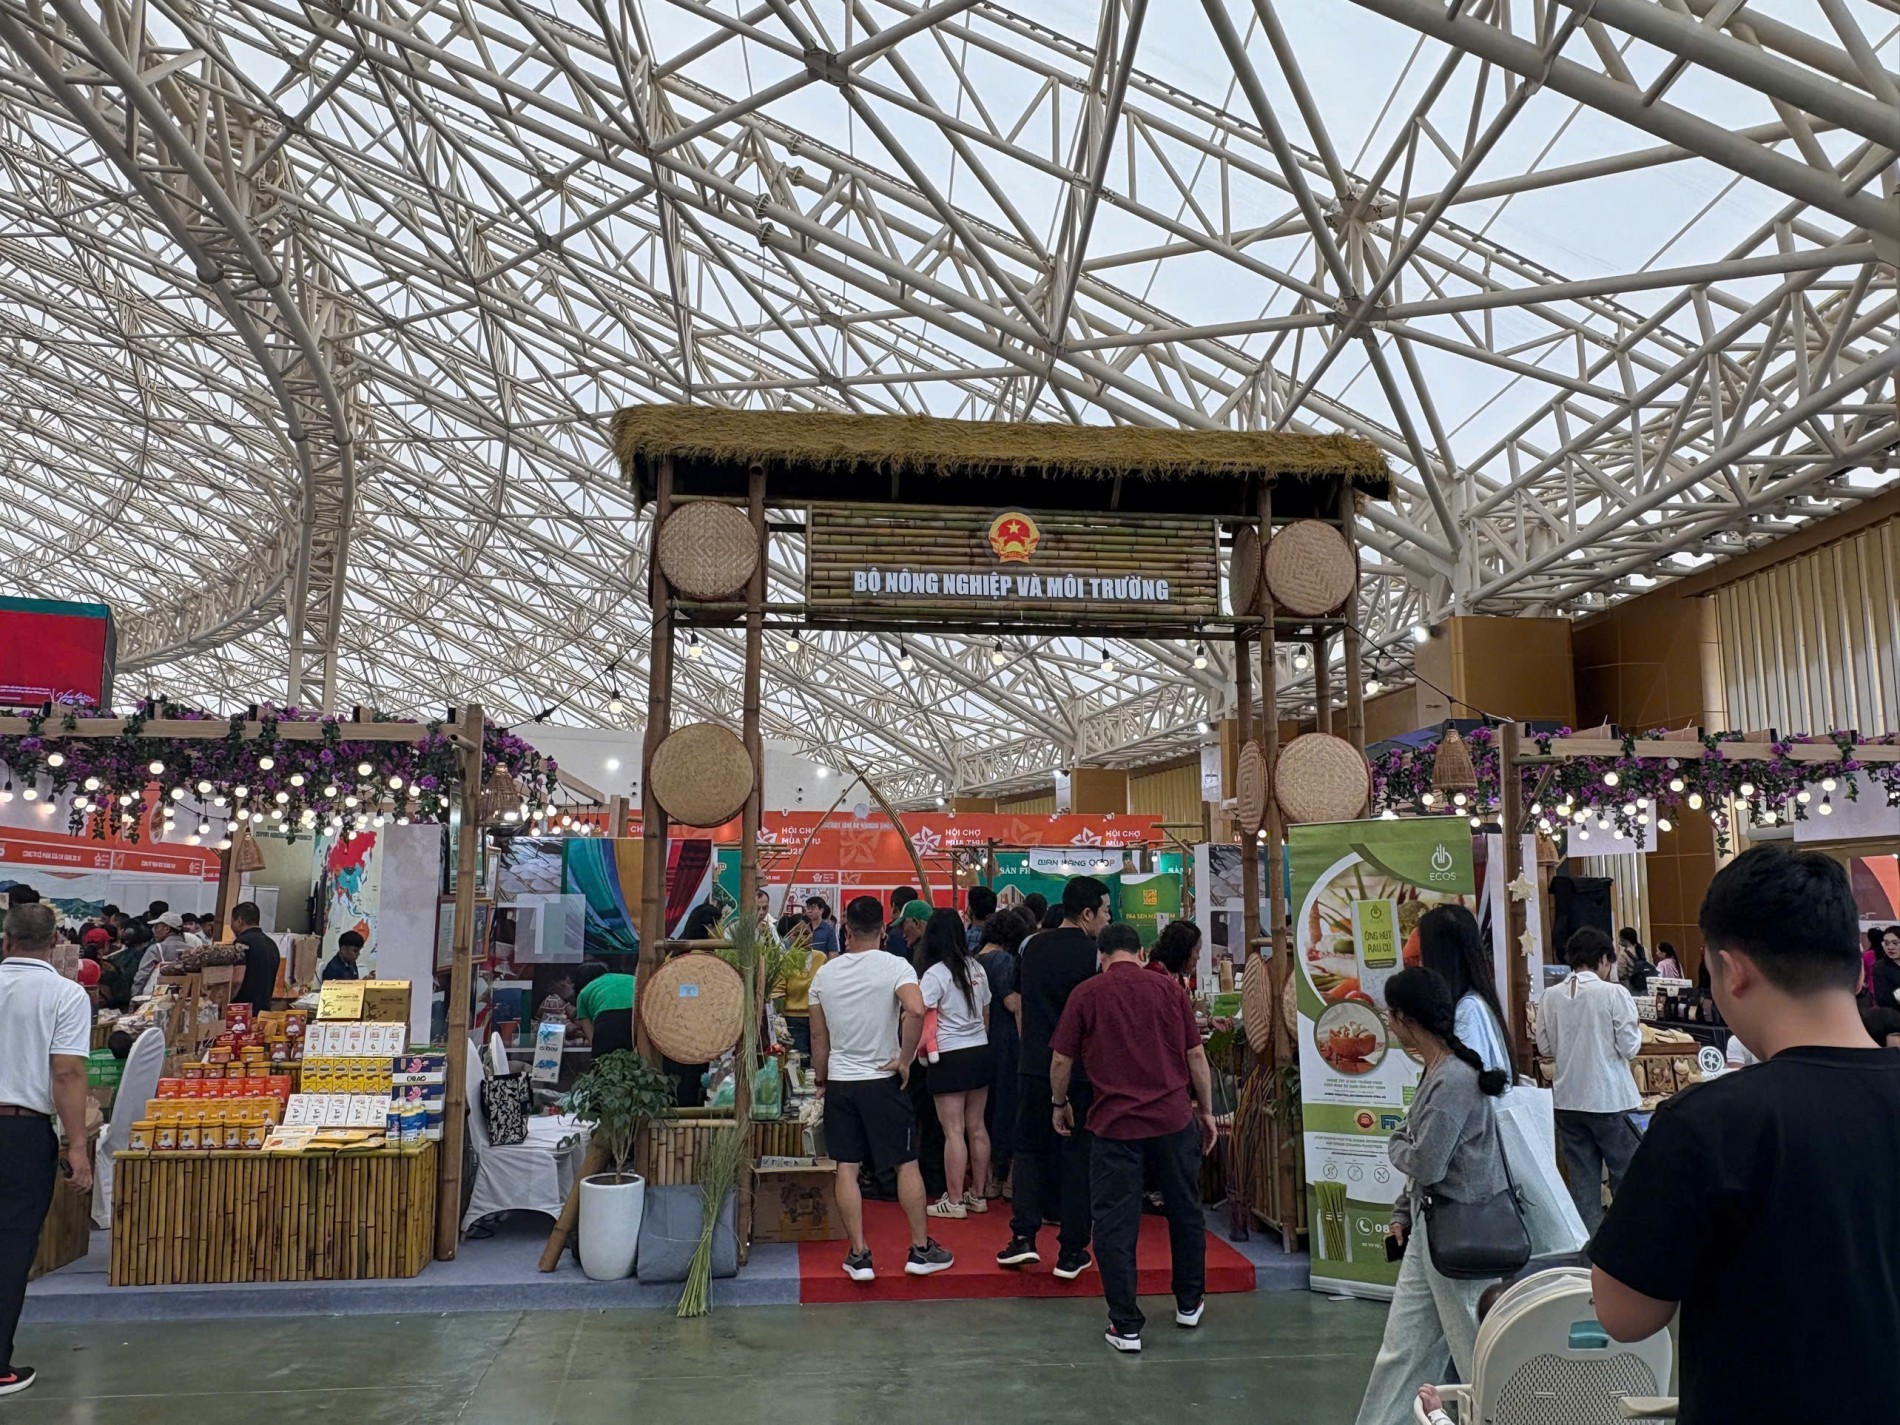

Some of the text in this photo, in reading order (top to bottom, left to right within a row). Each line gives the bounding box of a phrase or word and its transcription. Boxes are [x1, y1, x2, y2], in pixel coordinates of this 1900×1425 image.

[854, 567, 1169, 600] BỘ NÔNG NGHIỆP VÀ MÔI TRƯỜNG
[630, 825, 644, 833] CH
[1105, 829, 1141, 838] HỘI CHỢ
[1430, 872, 1456, 881] ECOS
[1381, 1114, 1402, 1130] FD
